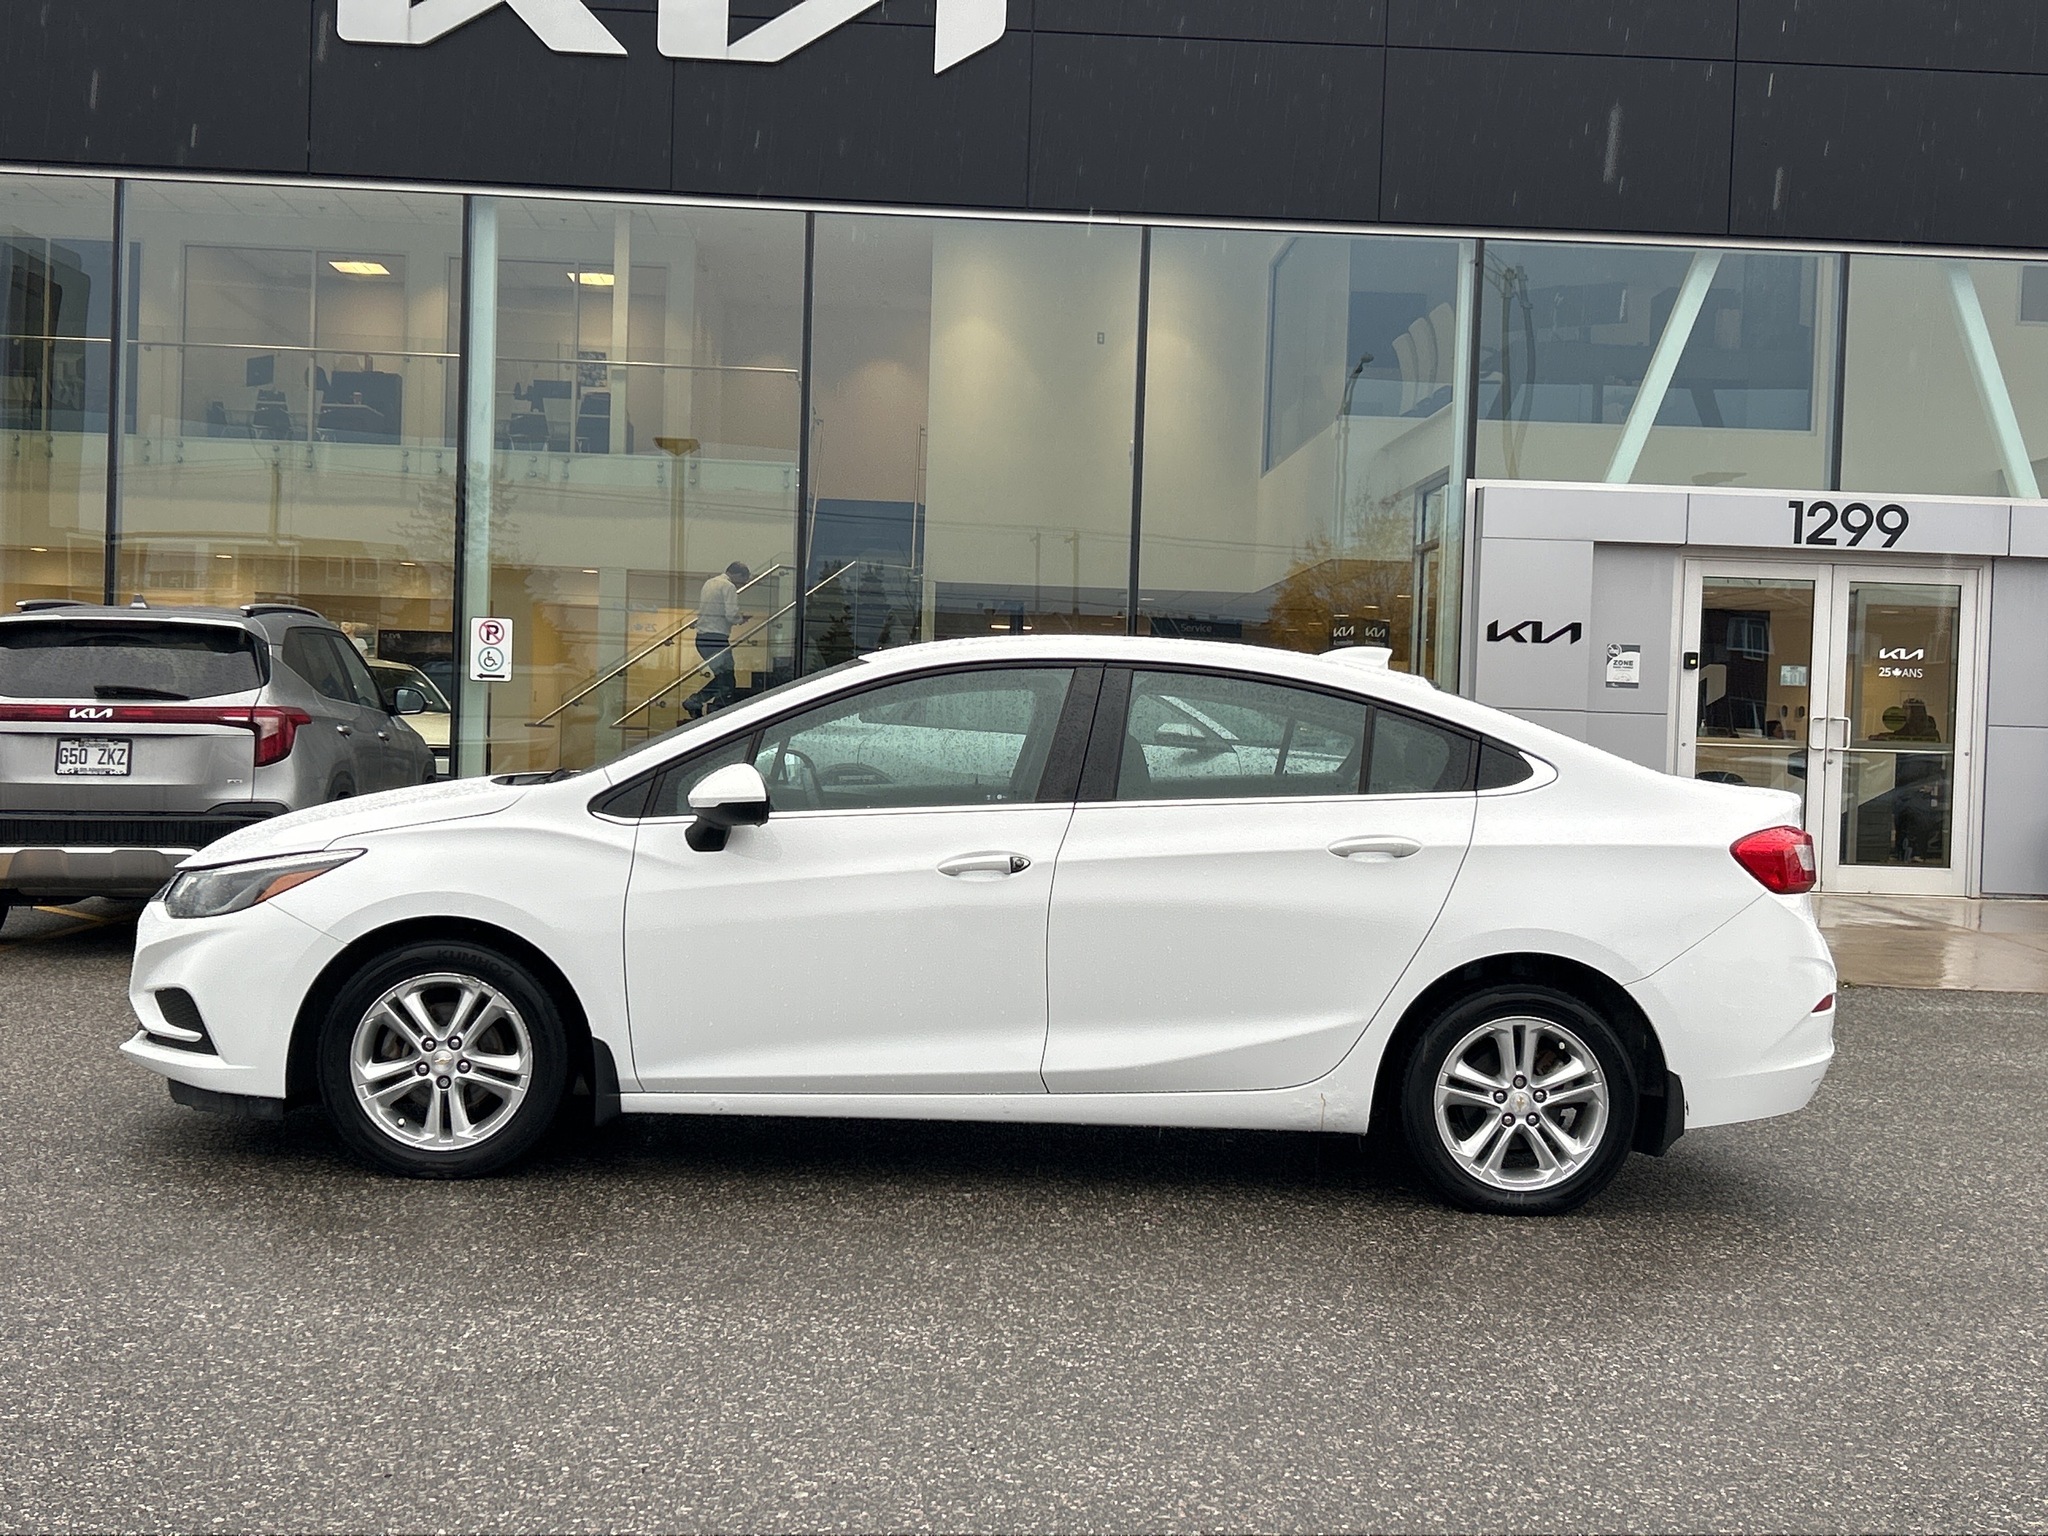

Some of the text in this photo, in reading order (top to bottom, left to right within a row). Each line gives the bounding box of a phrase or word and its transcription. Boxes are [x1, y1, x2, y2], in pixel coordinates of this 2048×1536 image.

[1788, 500, 1909, 548] 1299
[1180, 623, 1213, 633] Service
[1333, 626, 1355, 638] KIA
[1365, 626, 1386, 638] KIA
[1486, 620, 1582, 645] KIA
[1879, 647, 1924, 661] KIA
[1612, 659, 1634, 667] ZONE
[1878, 666, 1924, 679] 25 ANS
[69, 707, 114, 719] KIA
[59, 747, 127, 766] G50 ZKZ
[437, 950, 502, 972] KUMHO
